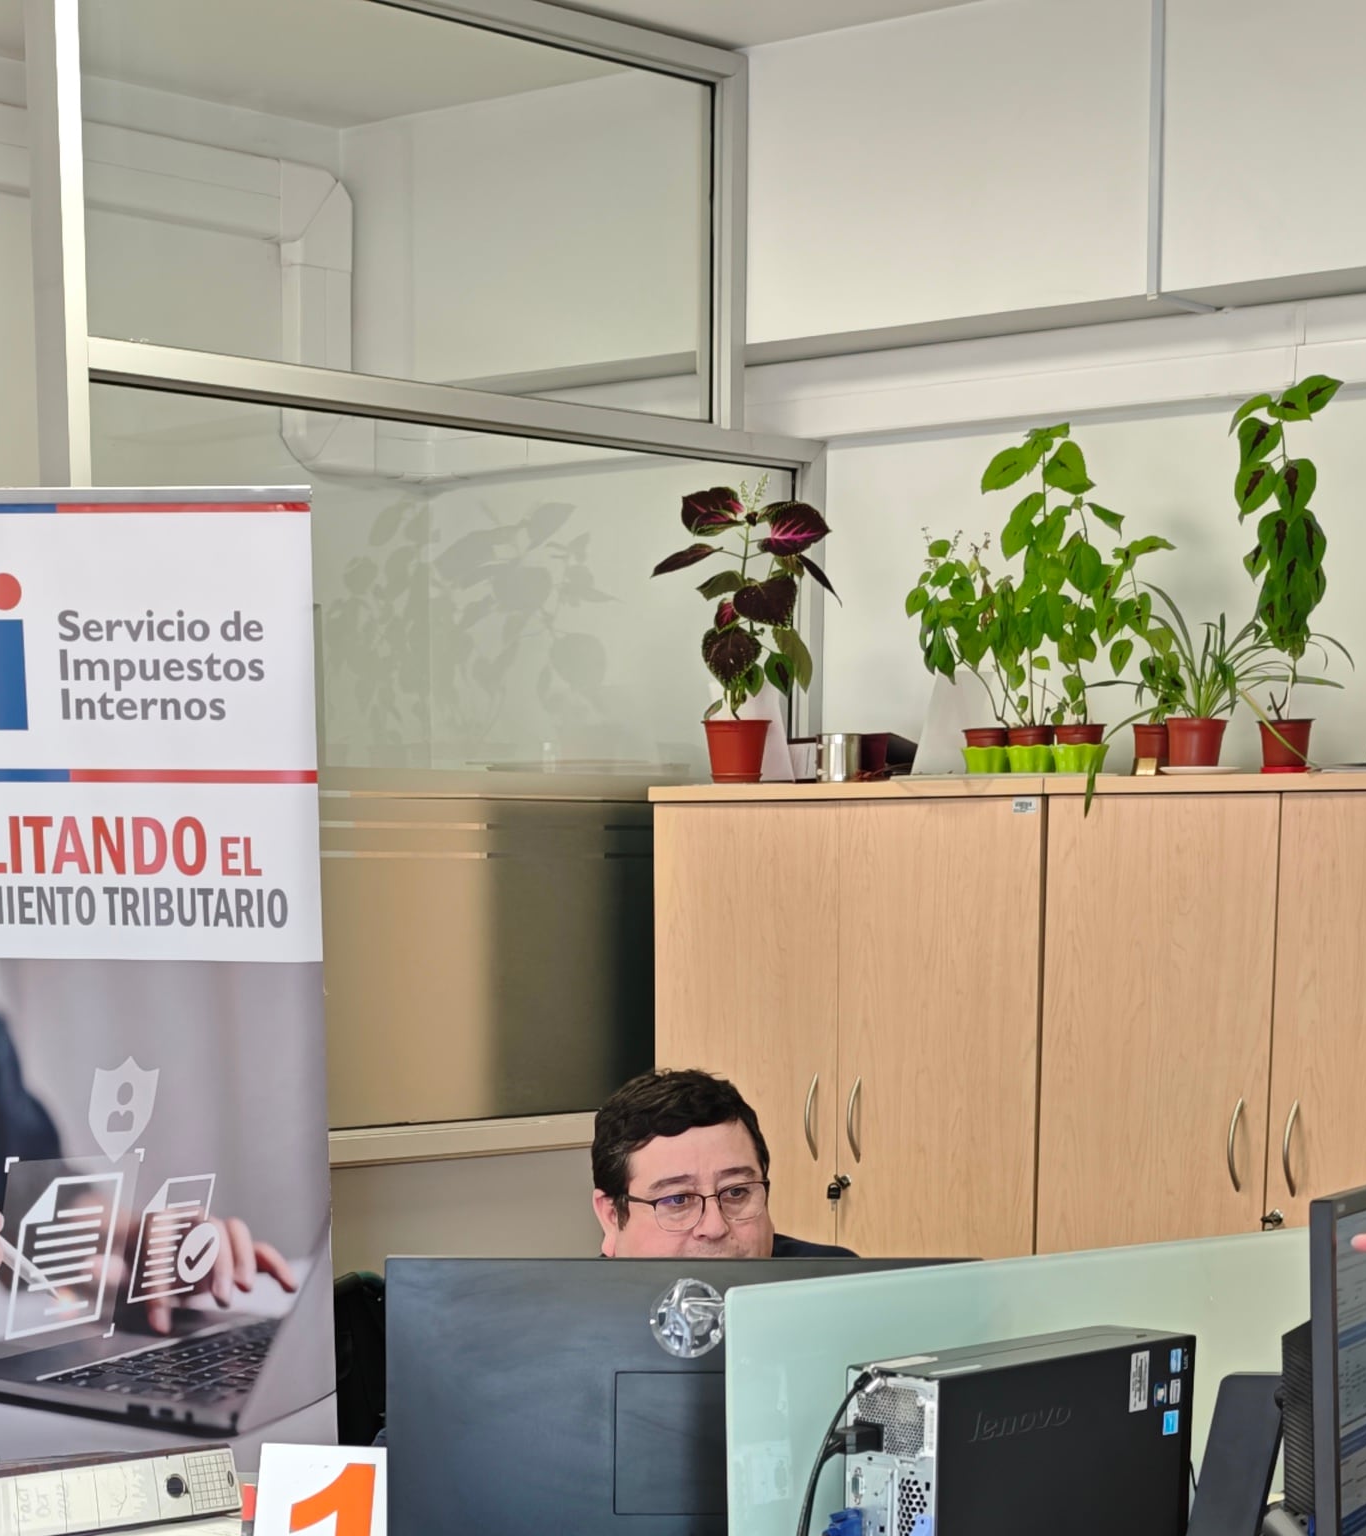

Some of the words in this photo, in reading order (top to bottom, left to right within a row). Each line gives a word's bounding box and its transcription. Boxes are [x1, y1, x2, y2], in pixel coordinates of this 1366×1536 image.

[57, 609, 212, 644] Servicio
[219, 609, 265, 643] de
[58, 648, 266, 691] Impuestos
[60, 688, 227, 722] Internos
[220, 836, 263, 878] EL
[102, 885, 289, 930] TRIBUTARIO
[968, 1407, 1072, 1443] lenovo
